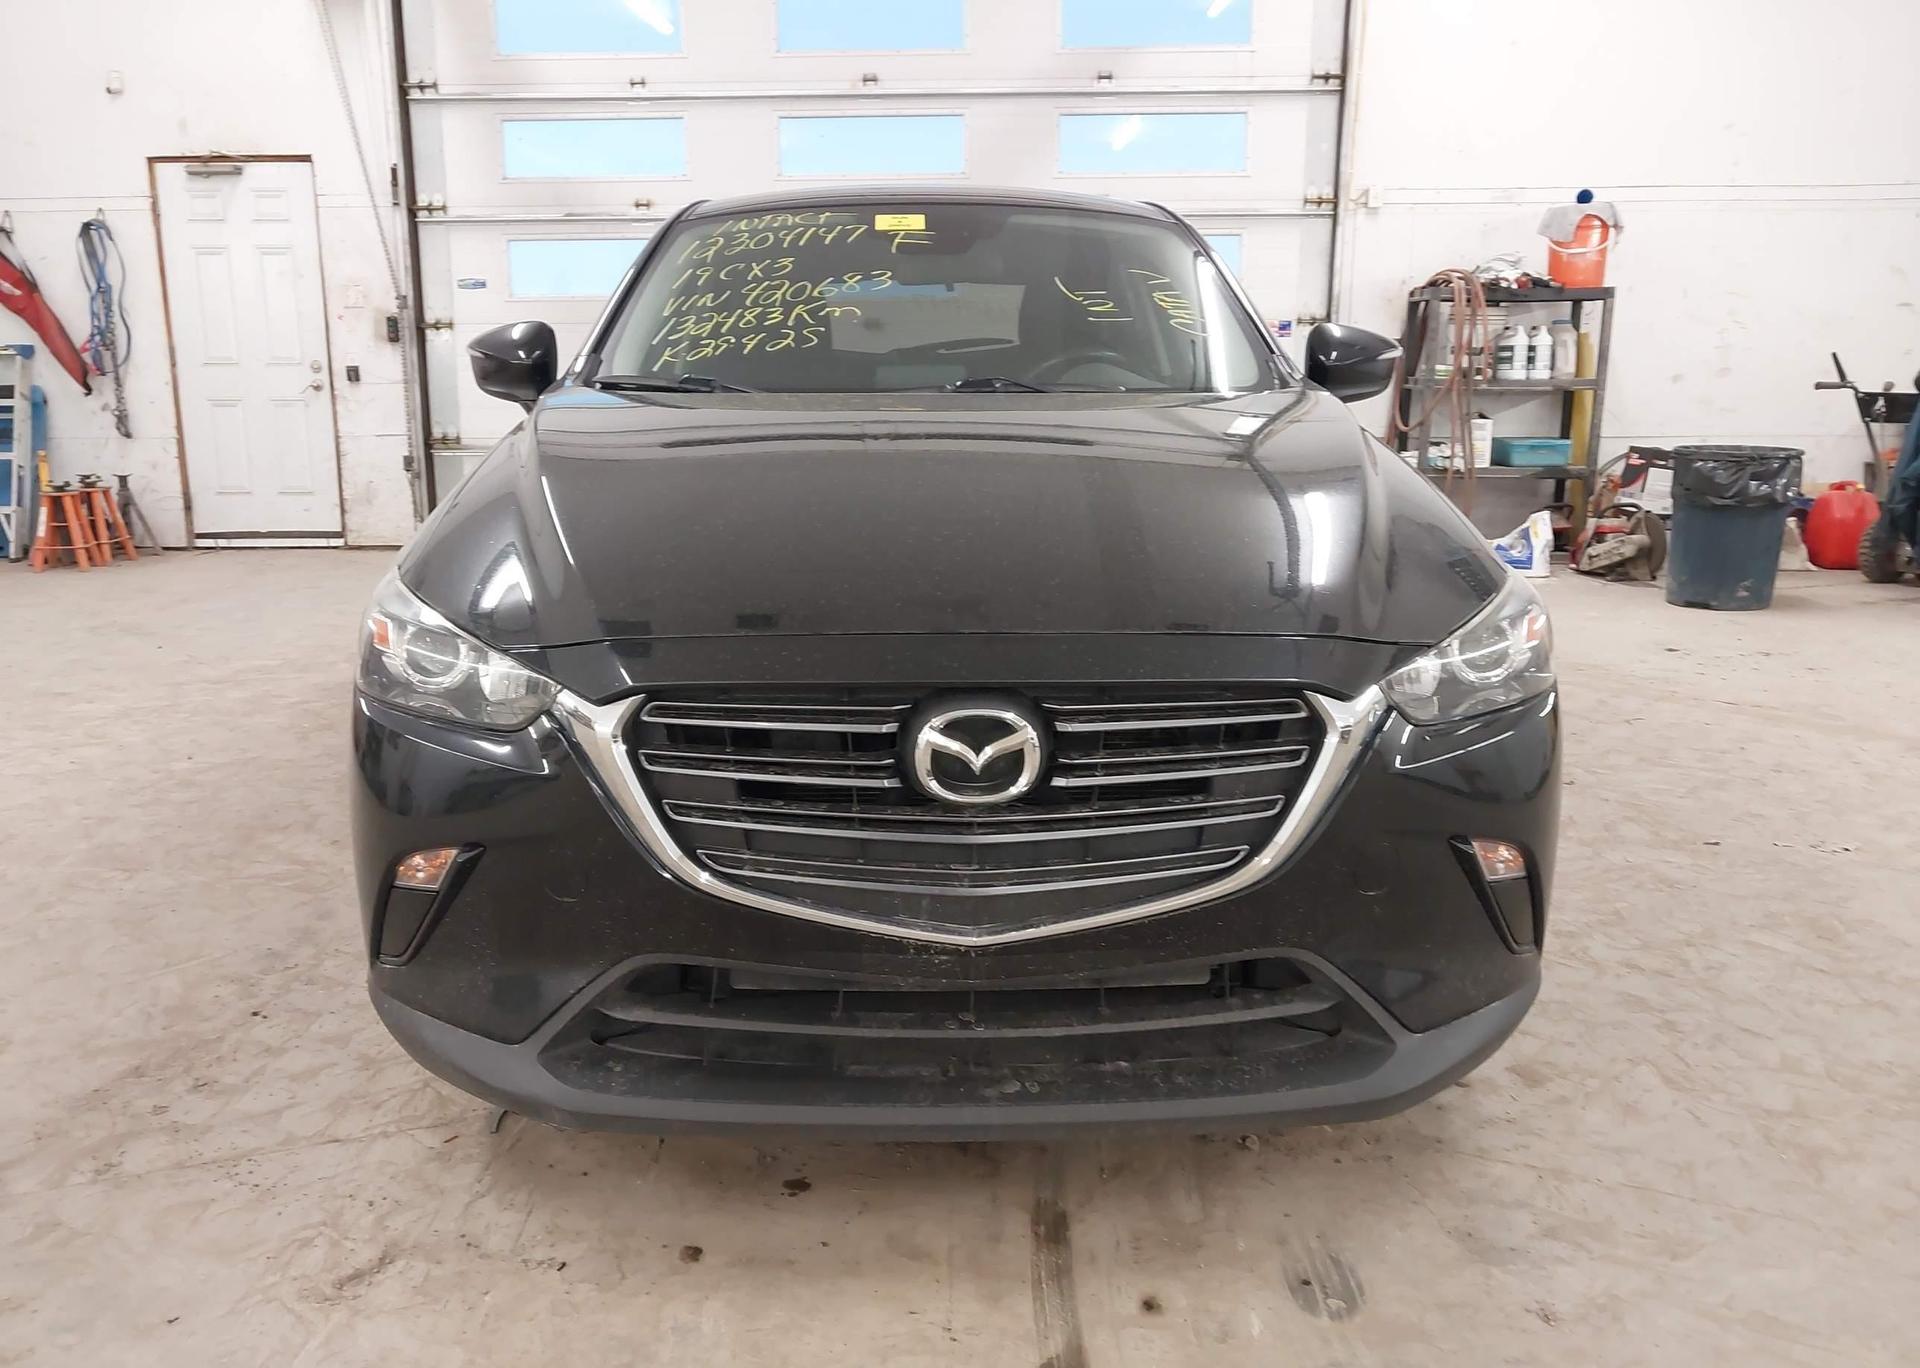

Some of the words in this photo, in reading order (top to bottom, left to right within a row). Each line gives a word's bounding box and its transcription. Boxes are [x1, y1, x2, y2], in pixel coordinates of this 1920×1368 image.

[712, 212, 858, 237] INTACT
[663, 290, 731, 316] VIN
[742, 270, 893, 307] 420683
